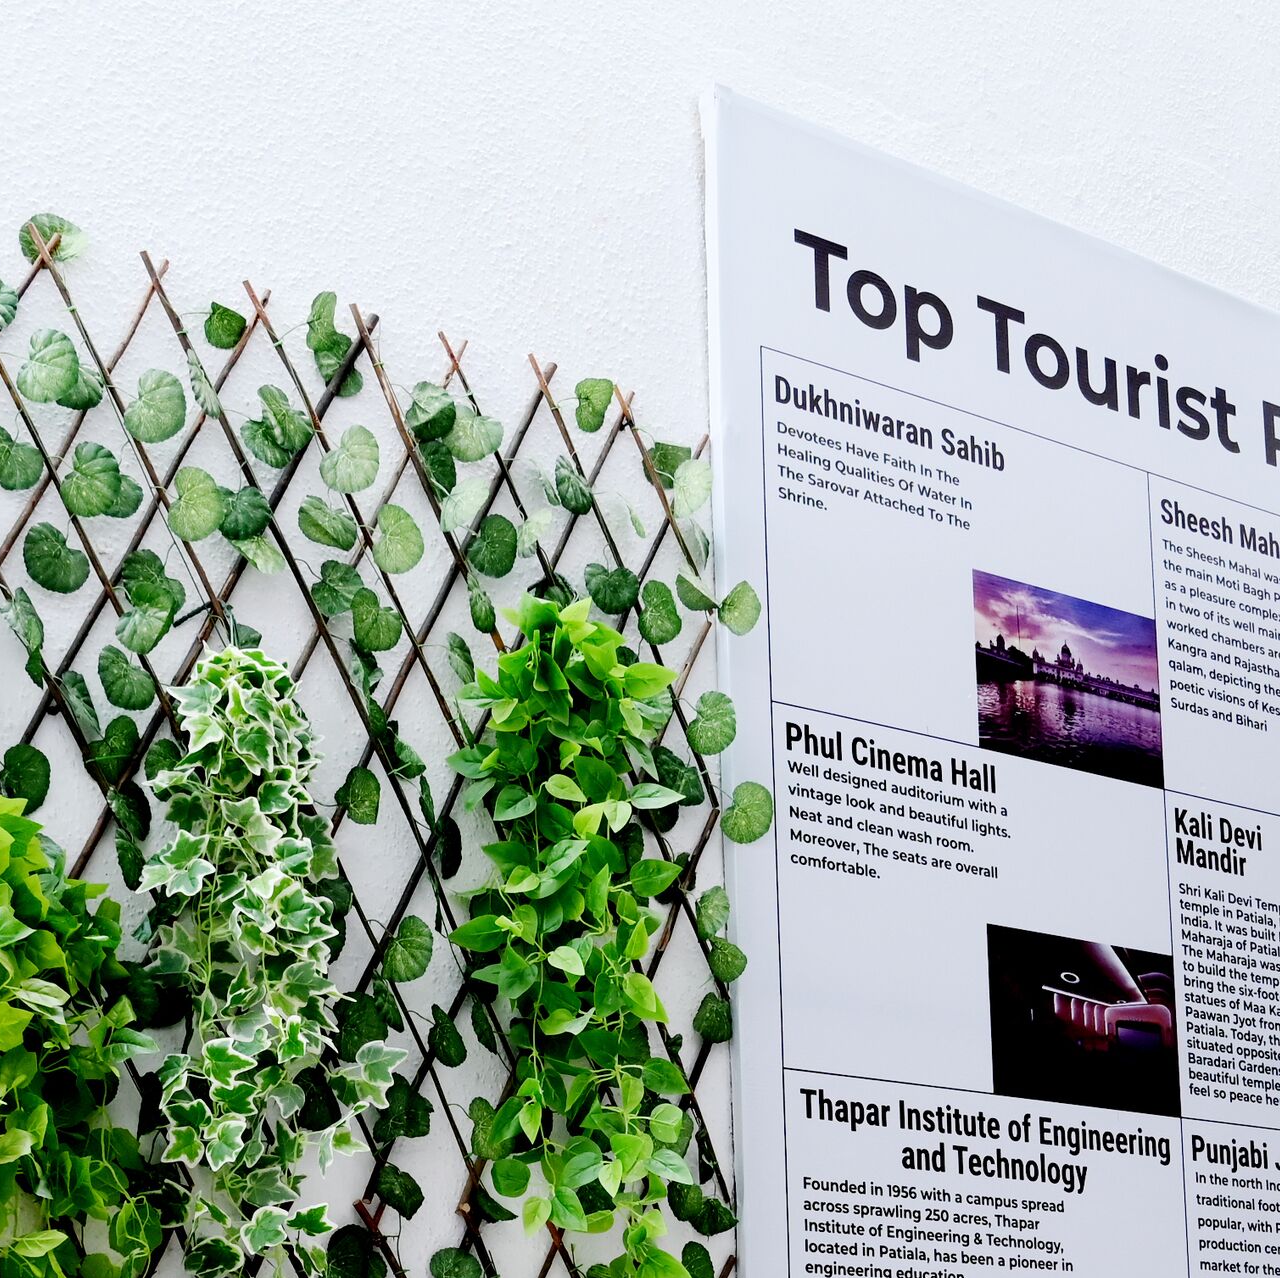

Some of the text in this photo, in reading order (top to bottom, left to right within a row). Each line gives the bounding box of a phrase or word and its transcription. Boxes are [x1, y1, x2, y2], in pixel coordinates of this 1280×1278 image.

[794, 228, 953, 363] Top
[976, 294, 1240, 453] Tourist
[775, 375, 1004, 471] Dukhniwaran Sahib
[777, 421, 959, 486] Devotees Have Faith In The
[778, 487, 827, 510] Shrine.
[1161, 498, 1233, 544] Sheesh
[1162, 538, 1183, 554] The
[1186, 546, 1225, 567] Sheesh
[1228, 560, 1260, 579] Mahal
[786, 722, 996, 794] Phul Cinema Hall
[787, 760, 1007, 817] Well designed auditorium with a
[1174, 807, 1262, 851] Kali Devi
[1176, 837, 1246, 876] Mandir
[1181, 929, 1232, 950] Maharaja
[1235, 939, 1247, 951] of
[1183, 974, 1214, 993] bring
[1216, 981, 1235, 994] the
[799, 1088, 1170, 1166] Thapar Institute of Engineering
[901, 1142, 1087, 1194] and Technology
[1191, 1134, 1268, 1173] Punjabi
[804, 1218, 1063, 1254] Institute of Engineering & Technology,
[1199, 1238, 1261, 1253] production
